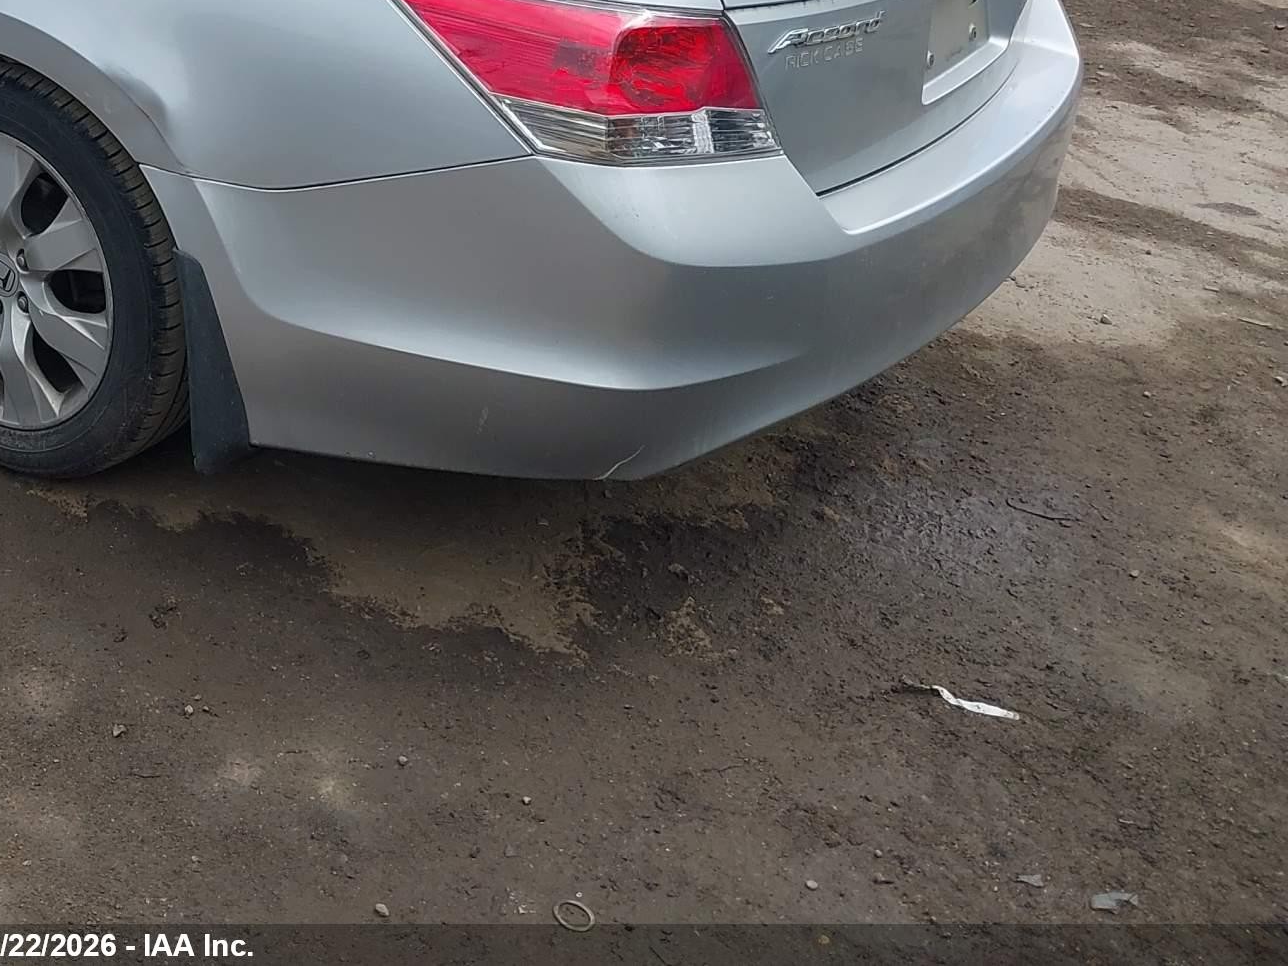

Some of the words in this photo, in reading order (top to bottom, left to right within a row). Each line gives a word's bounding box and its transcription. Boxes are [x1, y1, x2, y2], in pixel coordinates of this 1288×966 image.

[767, 10, 886, 54] Accord
[785, 48, 821, 70] RICK
[823, 37, 864, 62] CASE
